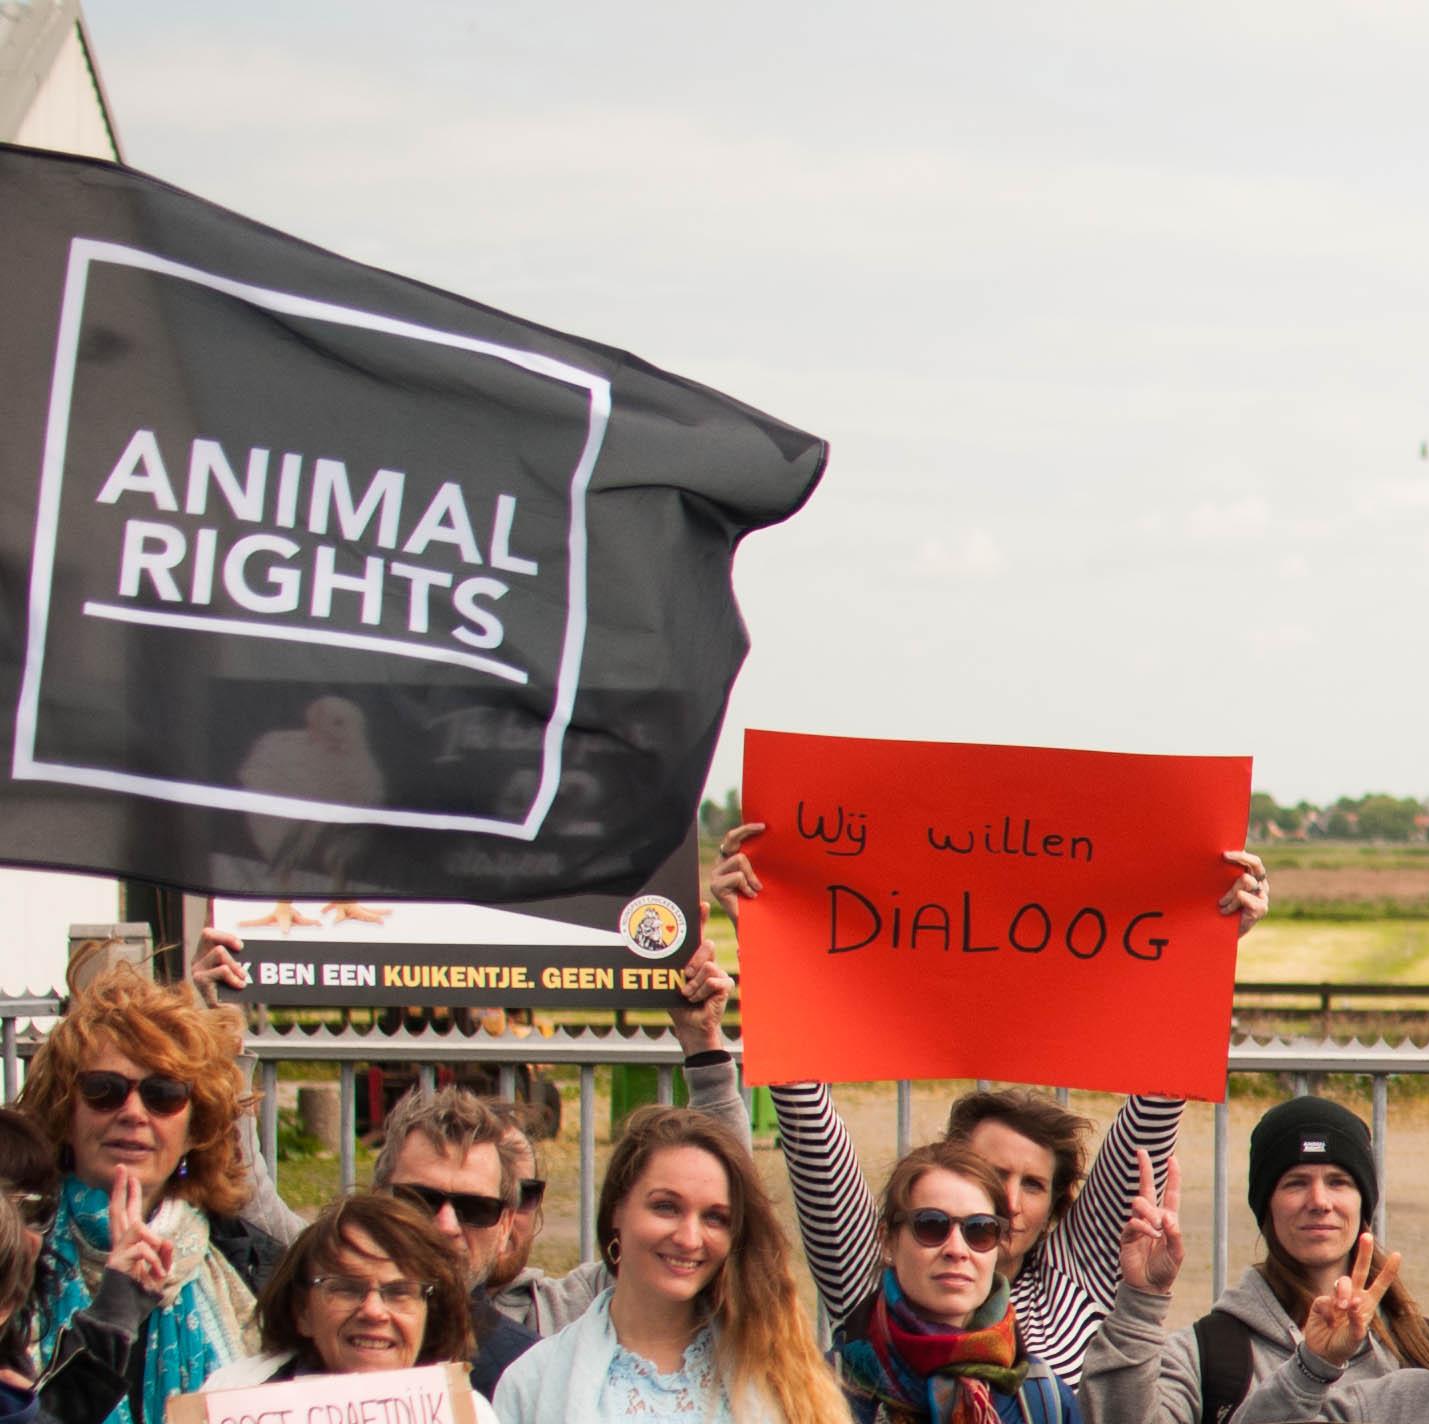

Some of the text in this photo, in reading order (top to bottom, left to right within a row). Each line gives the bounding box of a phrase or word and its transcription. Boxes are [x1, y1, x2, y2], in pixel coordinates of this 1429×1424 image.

[96, 429, 538, 576] ANIMAL
[117, 520, 509, 650] RIGHTS
[928, 817, 1093, 861] willen
[260, 962, 314, 985] BEN
[323, 963, 376, 986] EEN
[384, 964, 535, 990] KUIKENTJE.
[542, 967, 614, 990] GEEN
